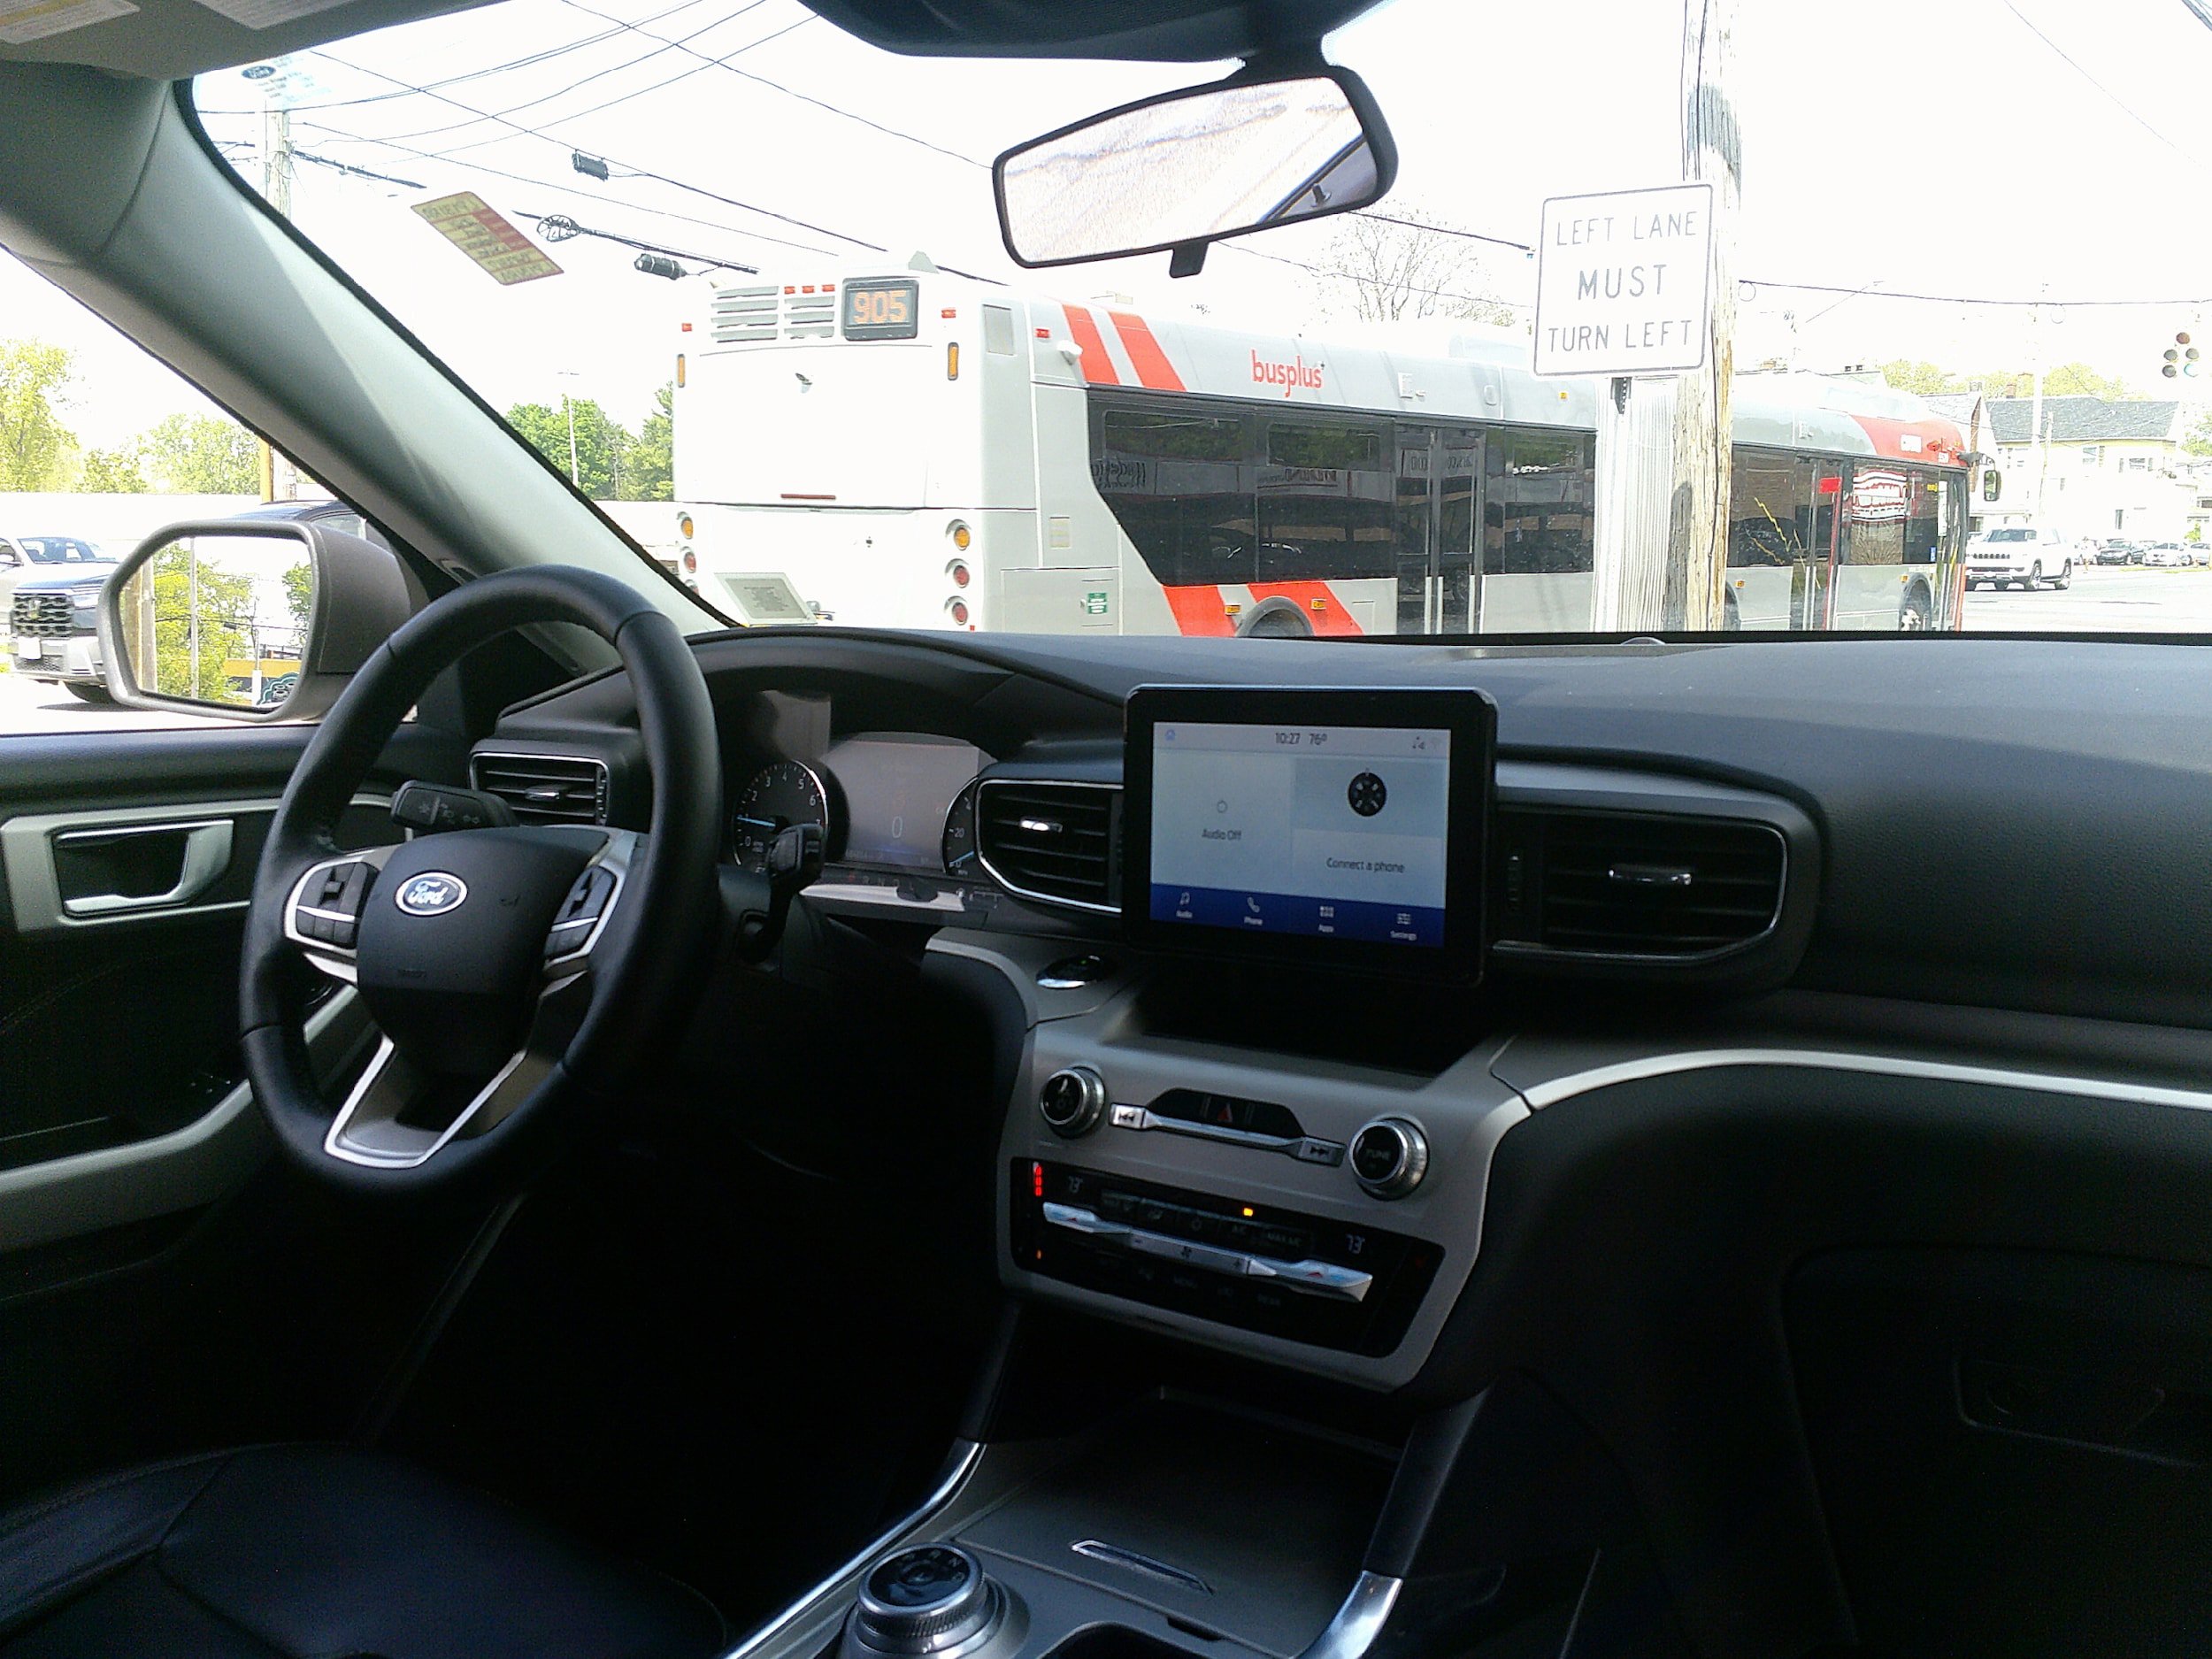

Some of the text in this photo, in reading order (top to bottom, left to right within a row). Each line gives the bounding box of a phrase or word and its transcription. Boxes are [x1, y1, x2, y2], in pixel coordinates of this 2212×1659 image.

[1556, 211, 1697, 246] LEFT LANE
[1578, 264, 1667, 300] MUST
[854, 289, 907, 324] 905
[1548, 319, 1692, 352] TURN LEFT
[1250, 349, 1322, 398] busplus
[1274, 732, 1301, 745] 10:27
[798, 780, 805, 790] 5
[750, 790, 758, 802] 2
[809, 795, 817, 807] 6
[1202, 828, 1225, 840] Audio
[1326, 857, 1405, 873] Connect a phone
[408, 880, 449, 905] Ford
